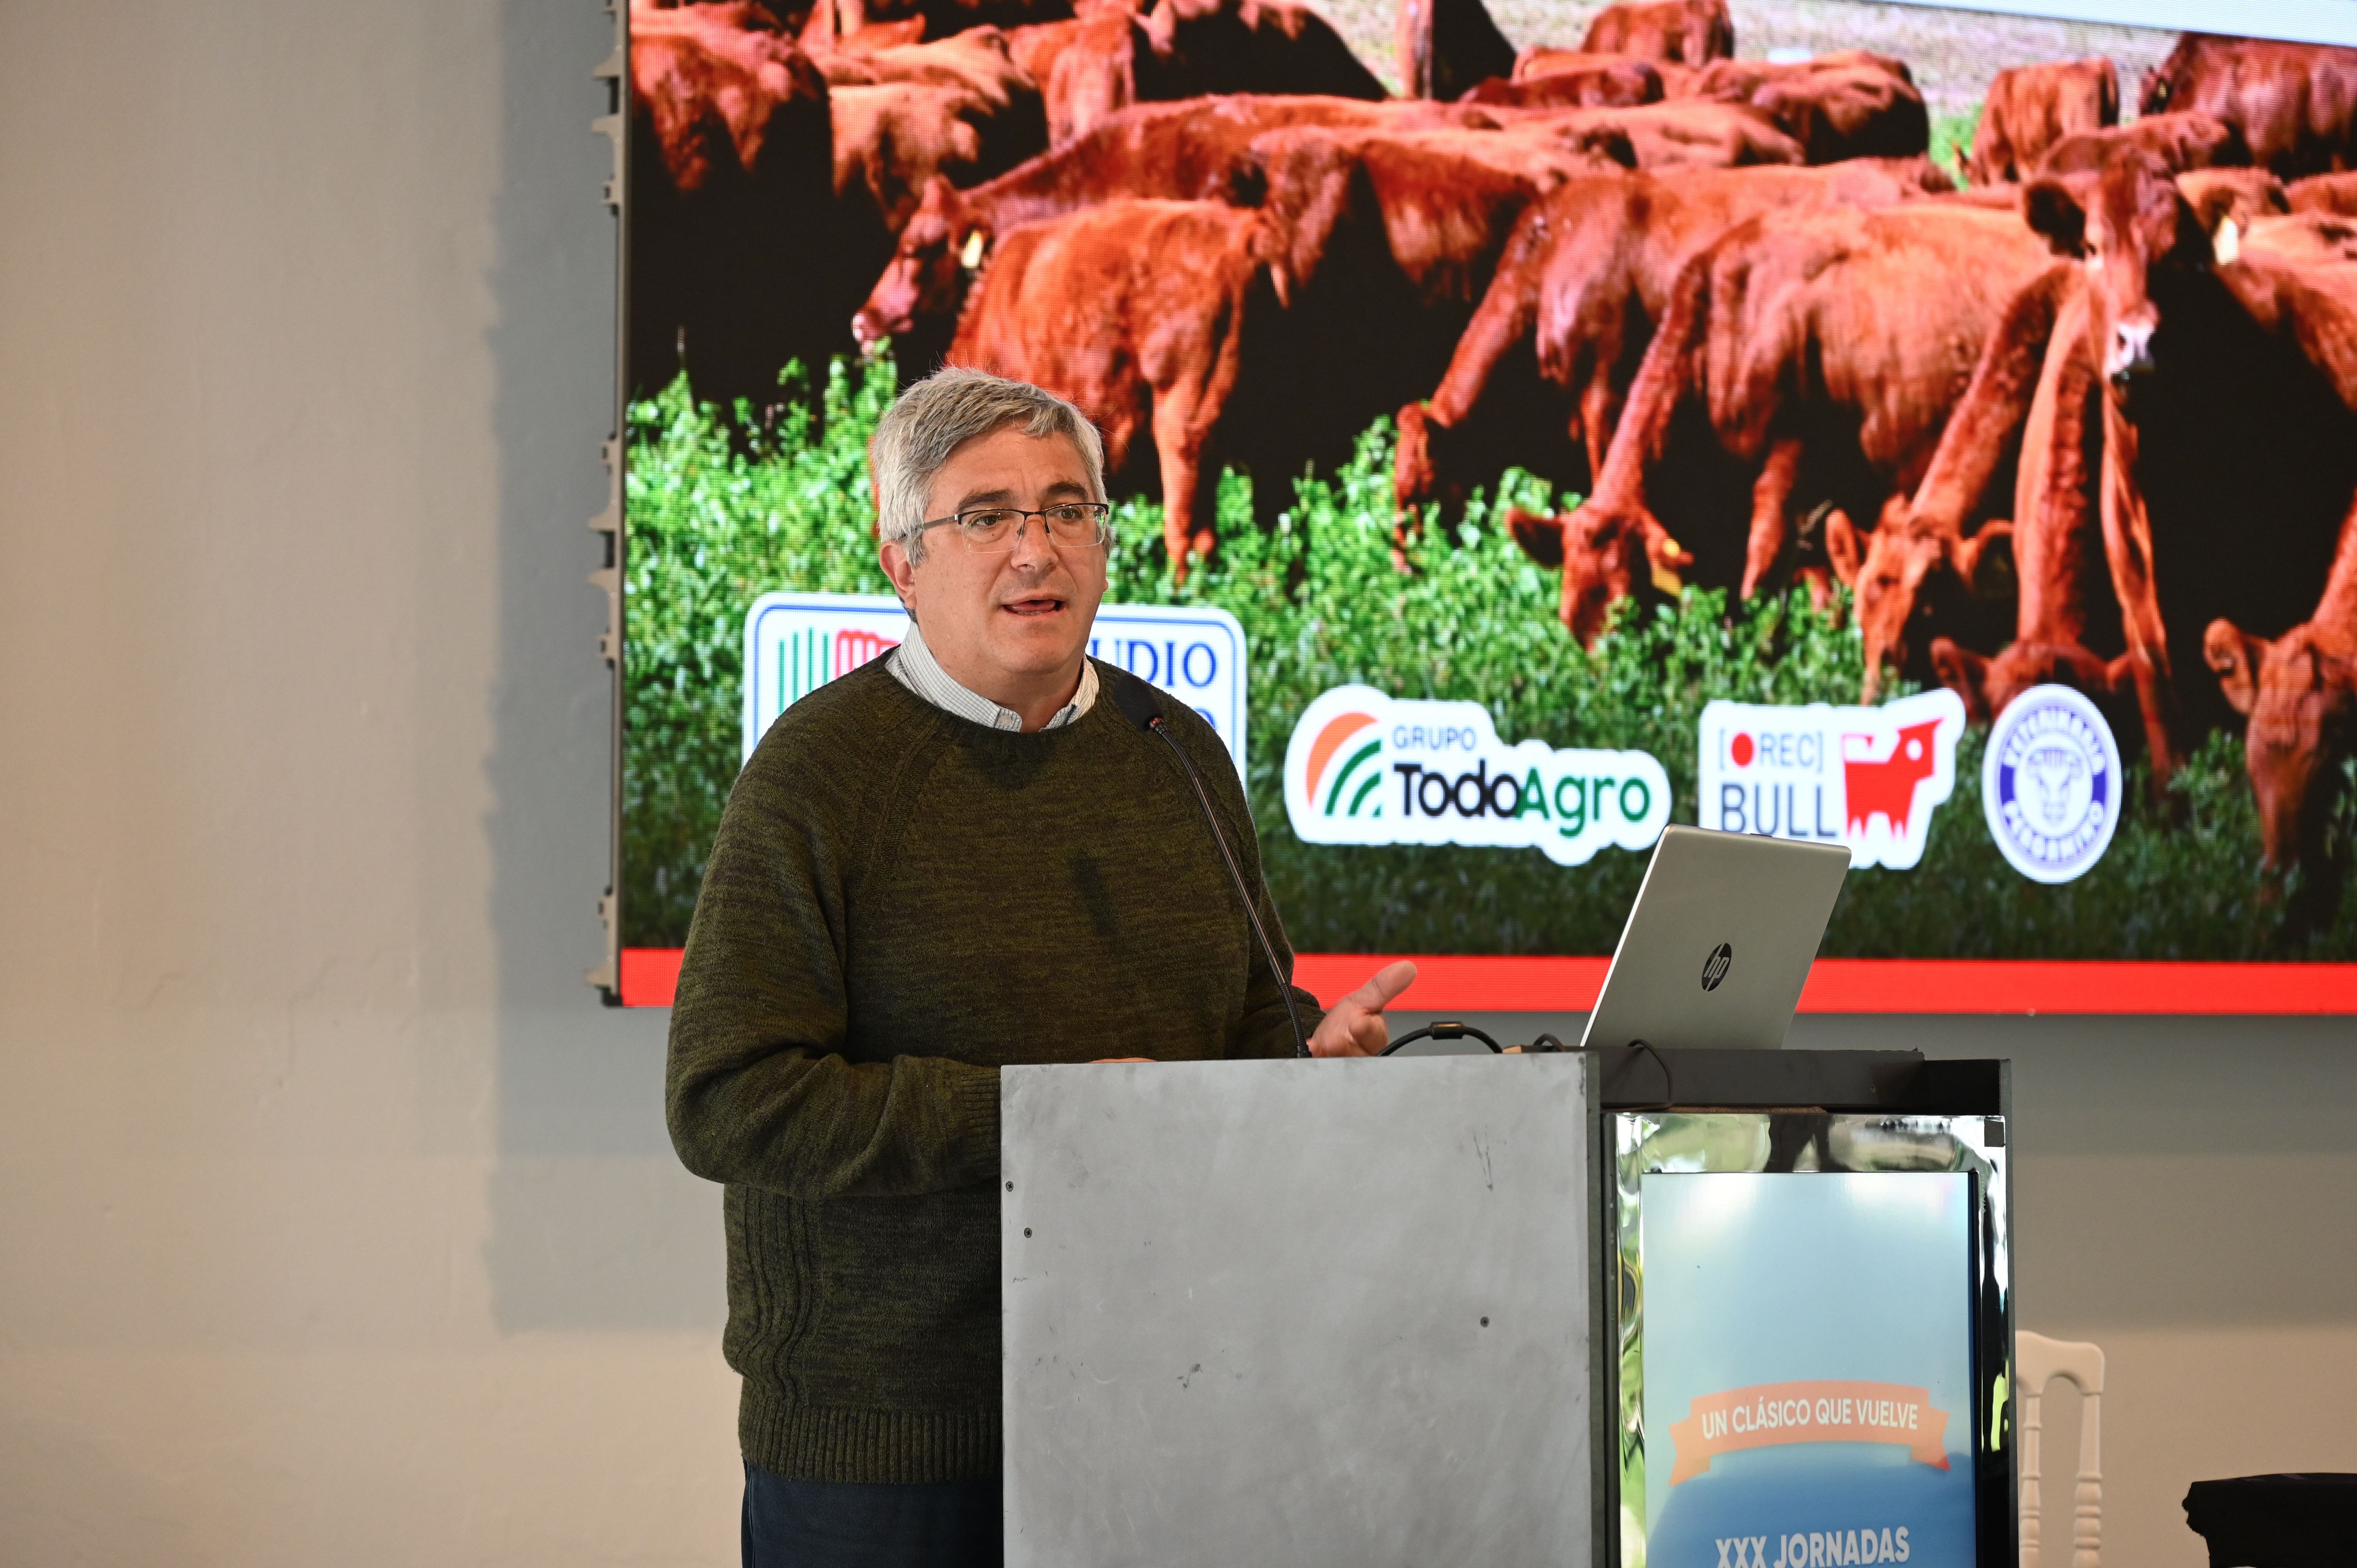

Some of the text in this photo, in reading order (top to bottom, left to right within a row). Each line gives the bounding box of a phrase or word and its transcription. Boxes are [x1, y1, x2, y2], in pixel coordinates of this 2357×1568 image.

[1393, 726, 1476, 750] GRUPO
[1394, 758, 1650, 837] TodoAgro
[1721, 782, 1837, 837] BULL
[1702, 943, 1732, 991] hp
[1702, 1396, 1918, 1439] UN CLÁSICO QUE VUELVE
[1715, 1526, 1910, 1568] XXX JORNADAS
